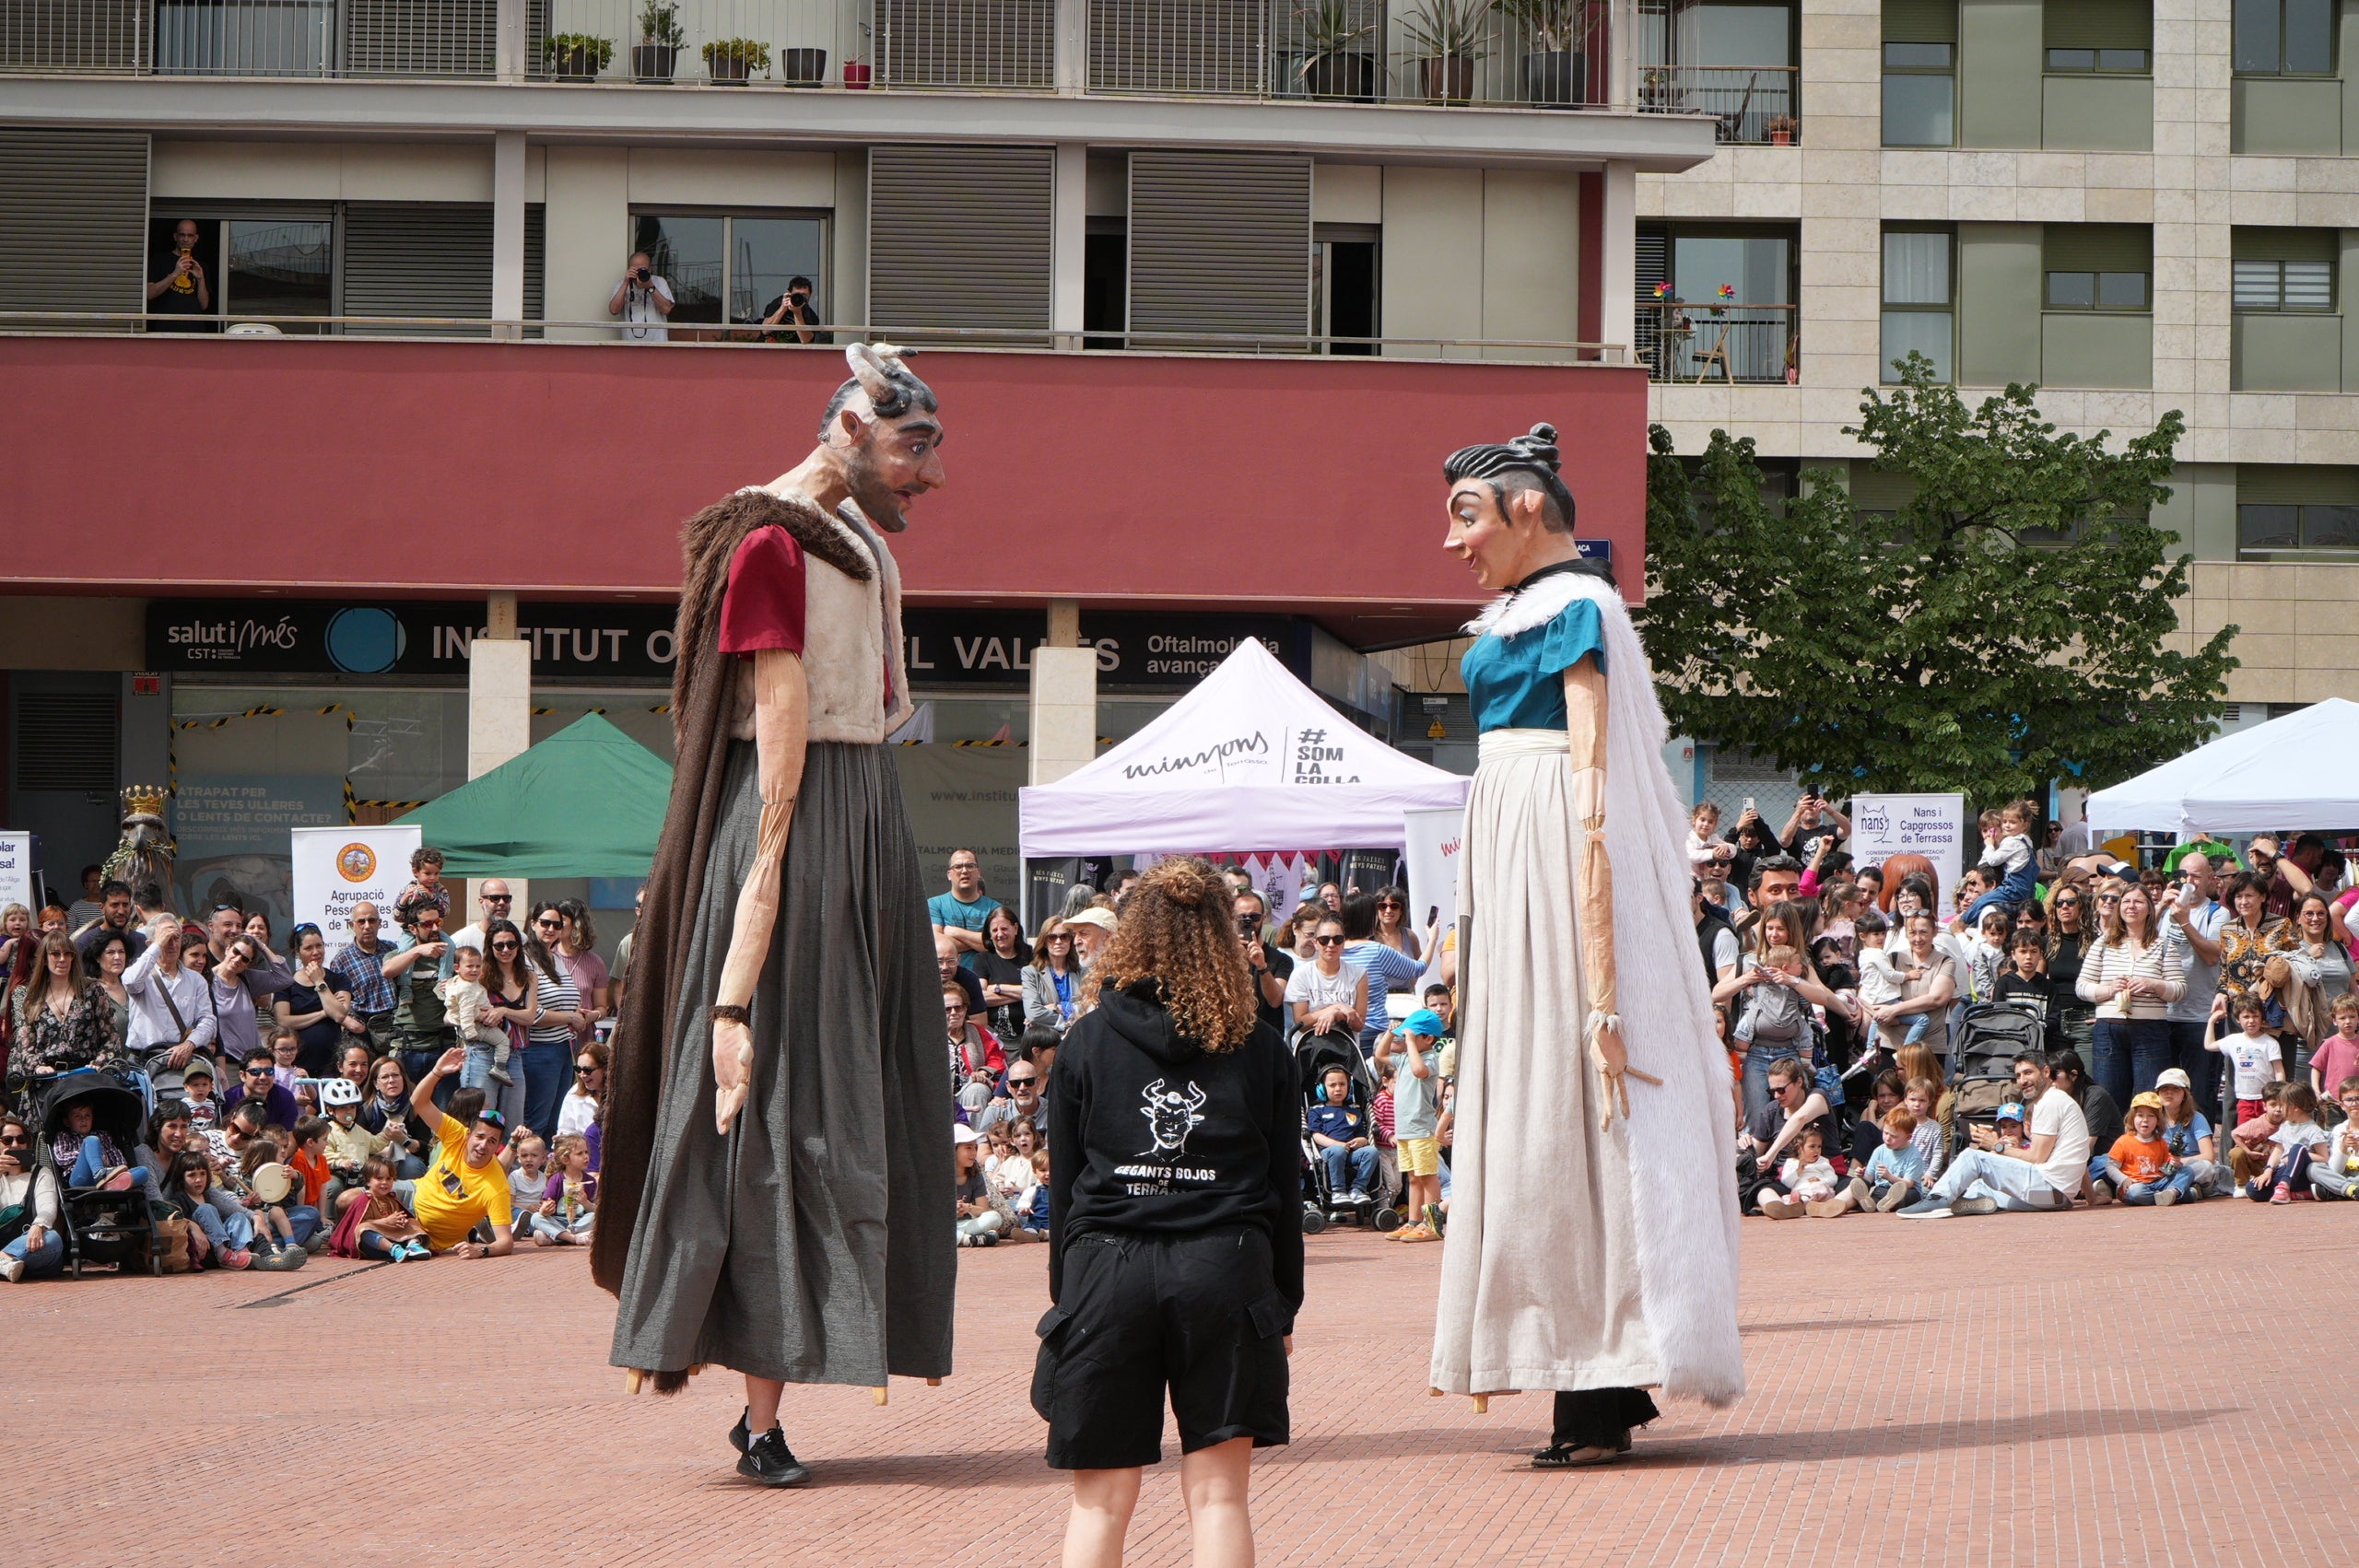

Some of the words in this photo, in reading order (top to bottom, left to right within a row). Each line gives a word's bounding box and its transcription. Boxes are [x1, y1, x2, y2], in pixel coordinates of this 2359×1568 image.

[168, 620, 226, 644] salut
[230, 621, 236, 644] i
[433, 626, 629, 662] INITUT
[1147, 635, 1280, 655] Oftalmolia
[953, 634, 1121, 672] VALS
[1146, 659, 1220, 679] avança
[1122, 731, 1269, 784] minyons
[1297, 745, 1344, 762] SOM
[1296, 762, 1322, 776] LA
[177, 787, 238, 797] ATRAPAT
[241, 788, 266, 797] PER
[931, 790, 1019, 802] www.institu
[177, 800, 200, 809] LES
[205, 800, 244, 810] TEVES
[248, 801, 304, 810] ULLERES
[177, 813, 187, 822] O
[190, 813, 230, 822] LENTS
[234, 813, 252, 823] DE
[254, 813, 333, 824] CONTACTE?
[1861, 816, 1884, 830] nans
[1913, 807, 1937, 817] Nans
[1900, 820, 1954, 832] Capgrossos
[1901, 834, 1912, 843] de
[1914, 834, 1953, 843] Terrassa
[992, 847, 1018, 855] MEDI
[331, 889, 384, 904] Agrupació
[324, 904, 392, 916] Pesstes
[328, 919, 342, 930] de
[1114, 1164, 1172, 1179] GEGANTS
[1176, 1166, 1216, 1181] BOJOS
